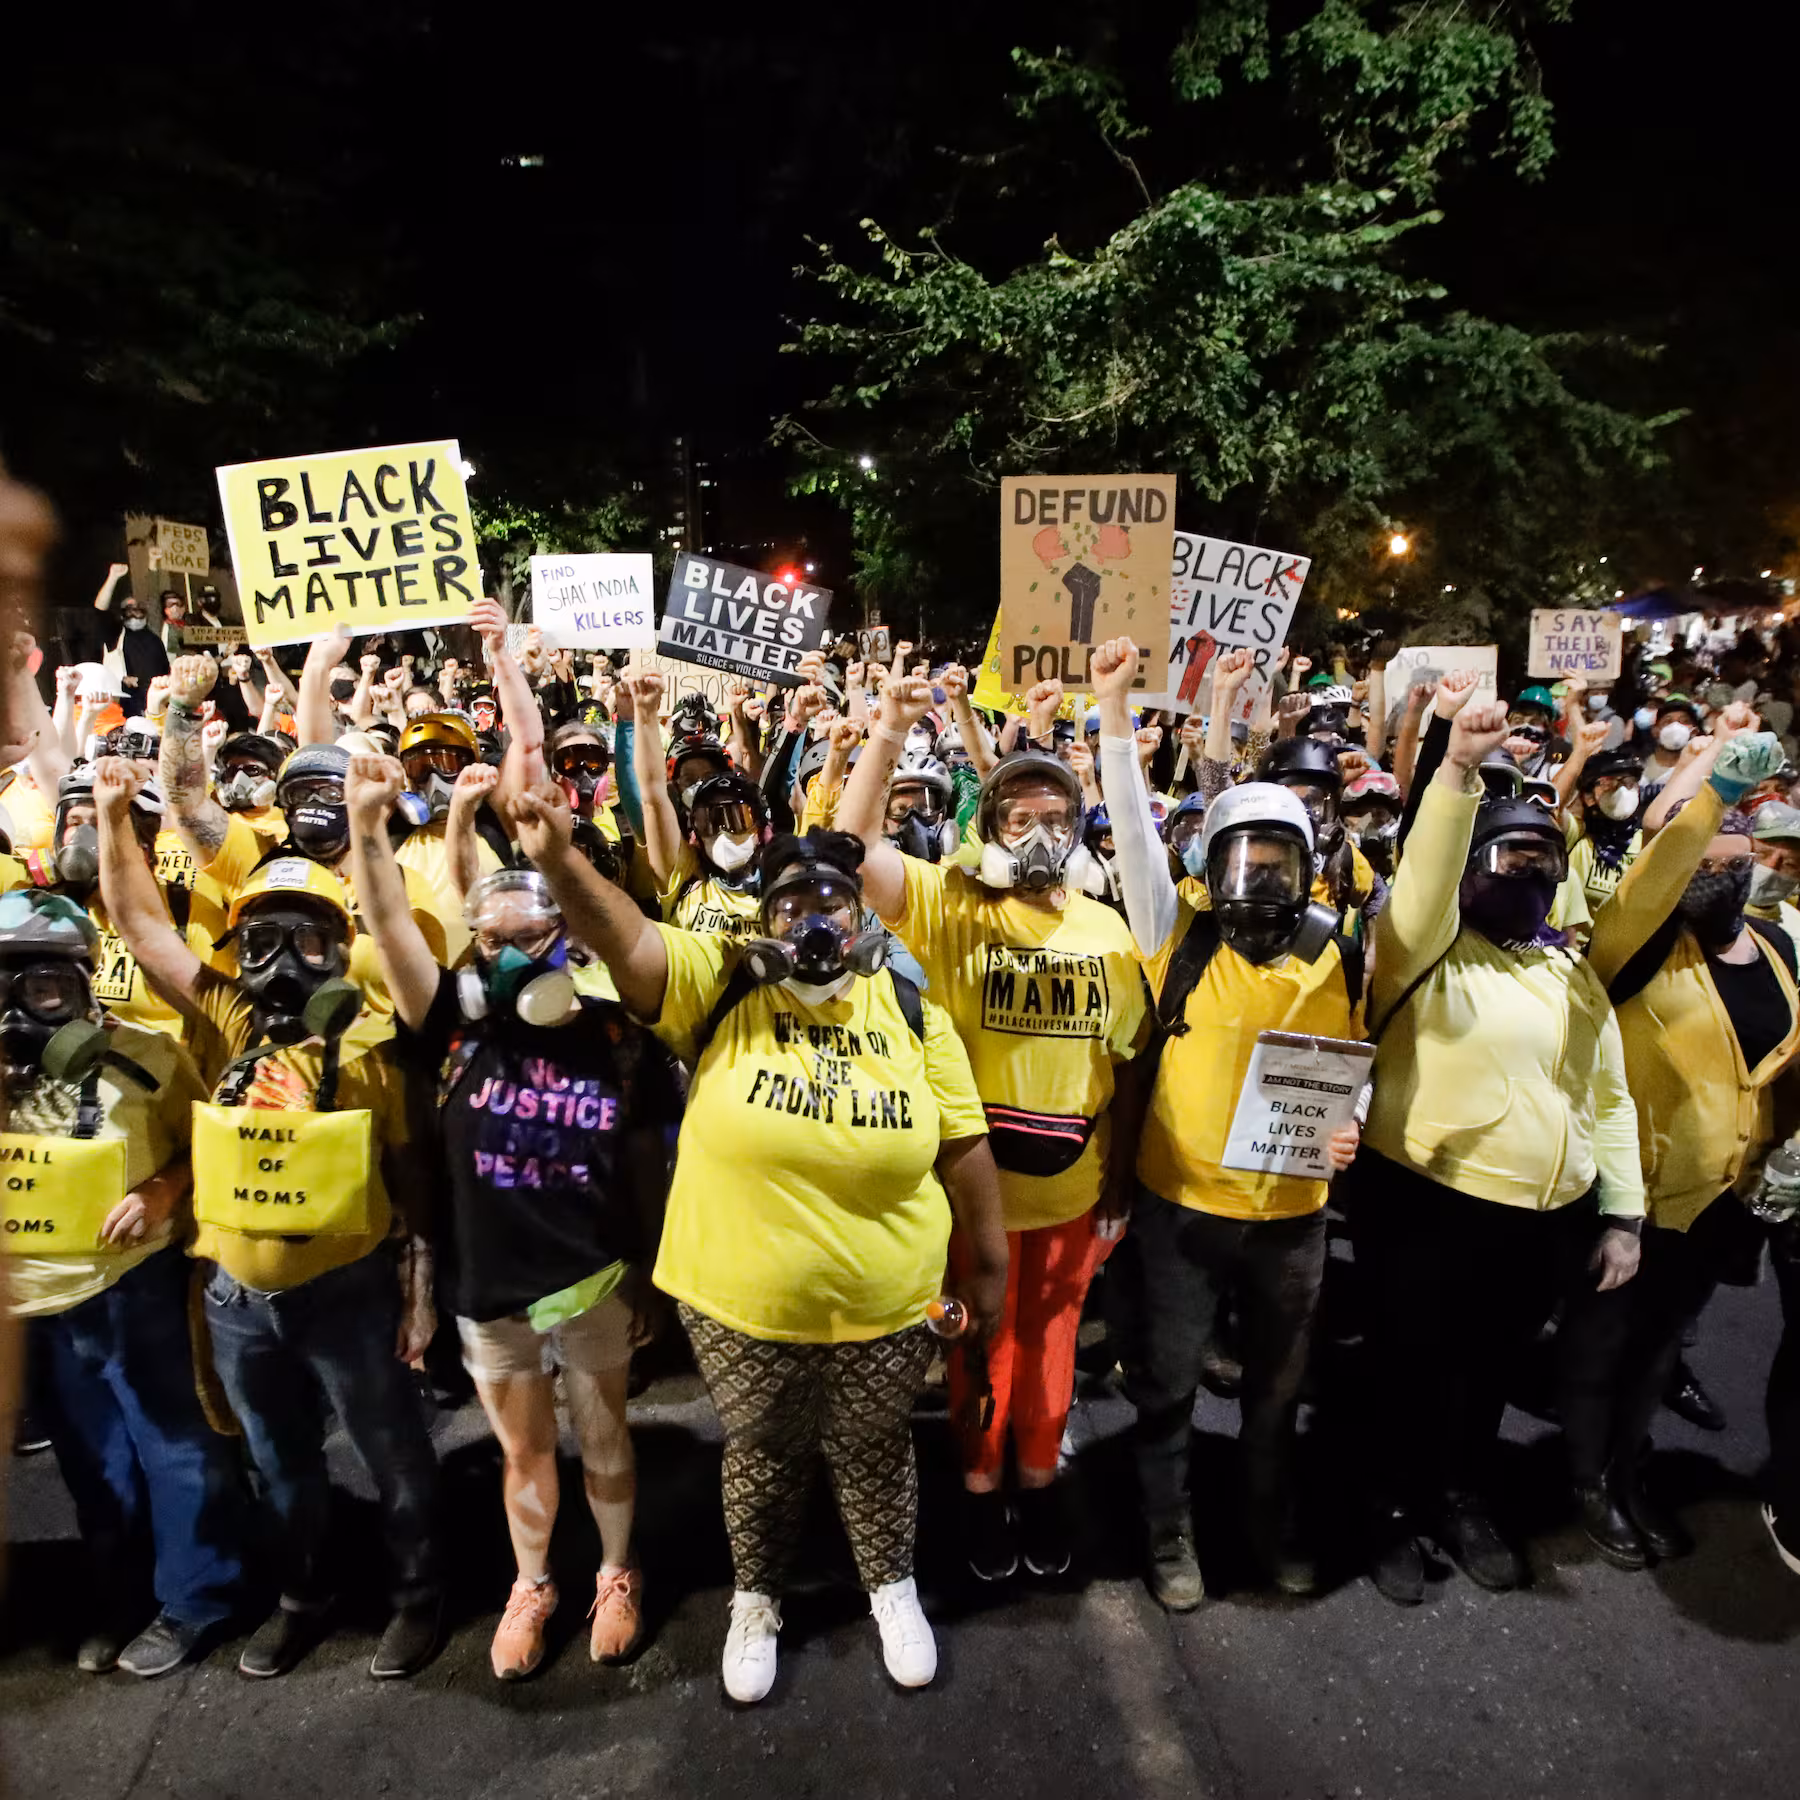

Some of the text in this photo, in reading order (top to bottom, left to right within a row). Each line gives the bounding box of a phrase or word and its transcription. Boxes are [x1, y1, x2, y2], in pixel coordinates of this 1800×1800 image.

[258, 458, 443, 532] BLACK
[1014, 487, 1168, 526] DEFUND
[162, 525, 202, 542] FEDS
[269, 513, 464, 578] LIVES
[540, 565, 576, 584] FIND
[1172, 536, 1303, 600] BLACK
[254, 556, 475, 624] MATTER
[683, 558, 821, 620] BLACK
[573, 610, 645, 633] KILLERS
[682, 591, 804, 646] LIVES
[1170, 589, 1284, 644] IVES
[1552, 613, 1603, 634] SAY
[671, 620, 803, 673] MATTER
[1544, 634, 1609, 653] THEIR
[695, 653, 728, 671] SILENCE
[735, 662, 772, 681] VIOLENCE
[1013, 644, 1152, 689] POLIE
[1549, 651, 1609, 671] NAMES
[994, 948, 1100, 978] SUMMONED
[988, 970, 1103, 1018] MAMA
[988, 1012, 1102, 1033] #BLACKLIVESMATTER
[808, 1024, 863, 1058] BEEN
[813, 1052, 852, 1086] THE
[746, 1069, 913, 1130] FRONT LINE
[1267, 1076, 1282, 1085] AM
[1282, 1077, 1301, 1088] NOT
[1302, 1080, 1321, 1091] THE
[1321, 1082, 1352, 1095] STORY
[468, 1077, 617, 1131] JUSTICE
[1270, 1101, 1329, 1119] BLACK
[238, 1125, 297, 1144] WALL
[1268, 1121, 1317, 1138] LIVES
[258, 1156, 288, 1173] OF
[1250, 1141, 1321, 1160] MATTER
[7, 1176, 36, 1192] OF
[233, 1187, 308, 1206] MOMS
[4, 1218, 55, 1234] OMS
